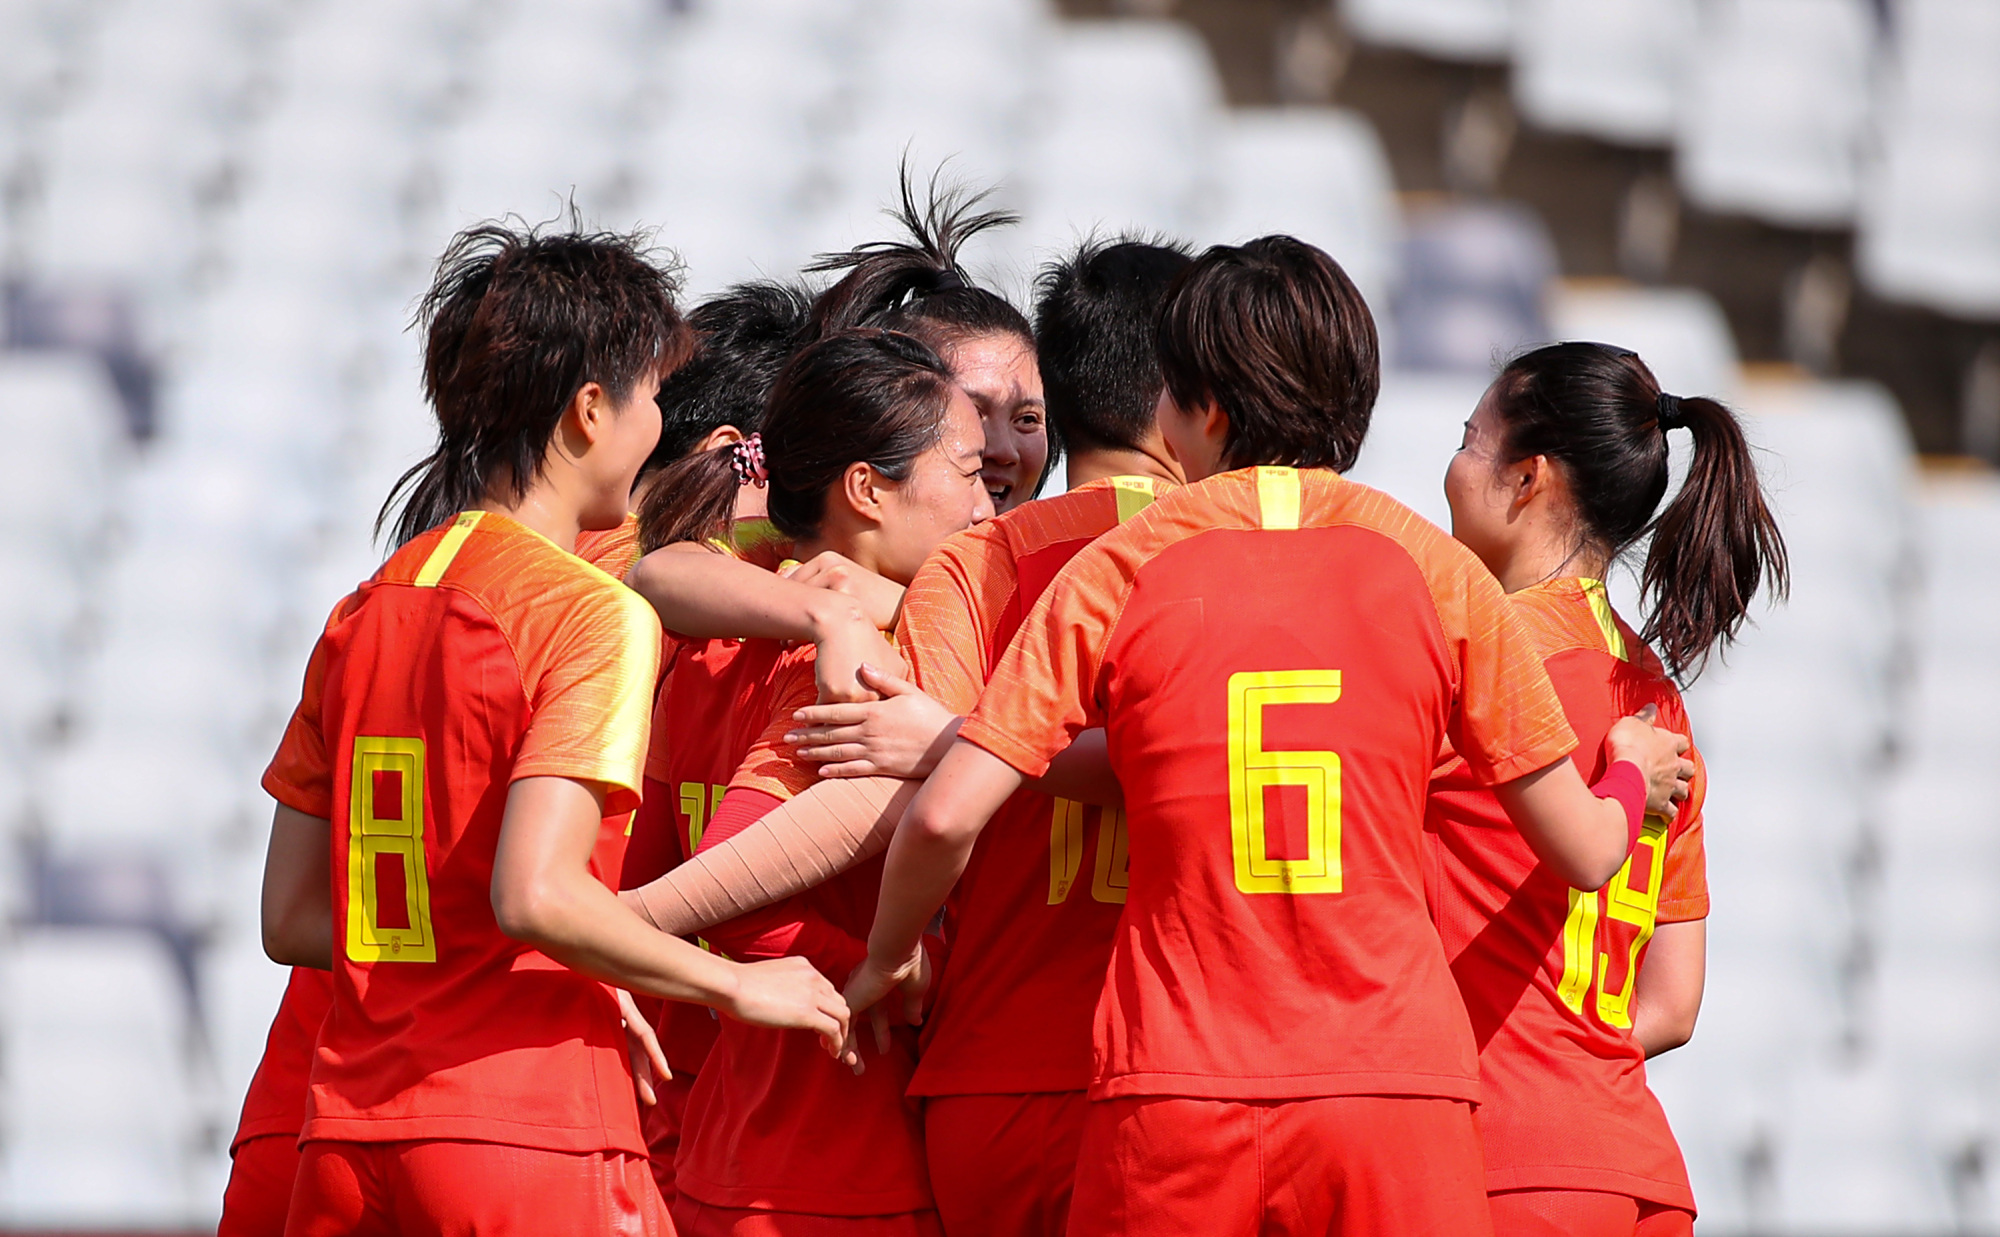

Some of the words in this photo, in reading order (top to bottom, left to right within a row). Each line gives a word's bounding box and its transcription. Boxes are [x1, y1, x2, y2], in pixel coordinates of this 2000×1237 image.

[346, 736, 437, 963] 8
[1227, 669, 1343, 894] 6
[1557, 814, 1669, 1029] 19
